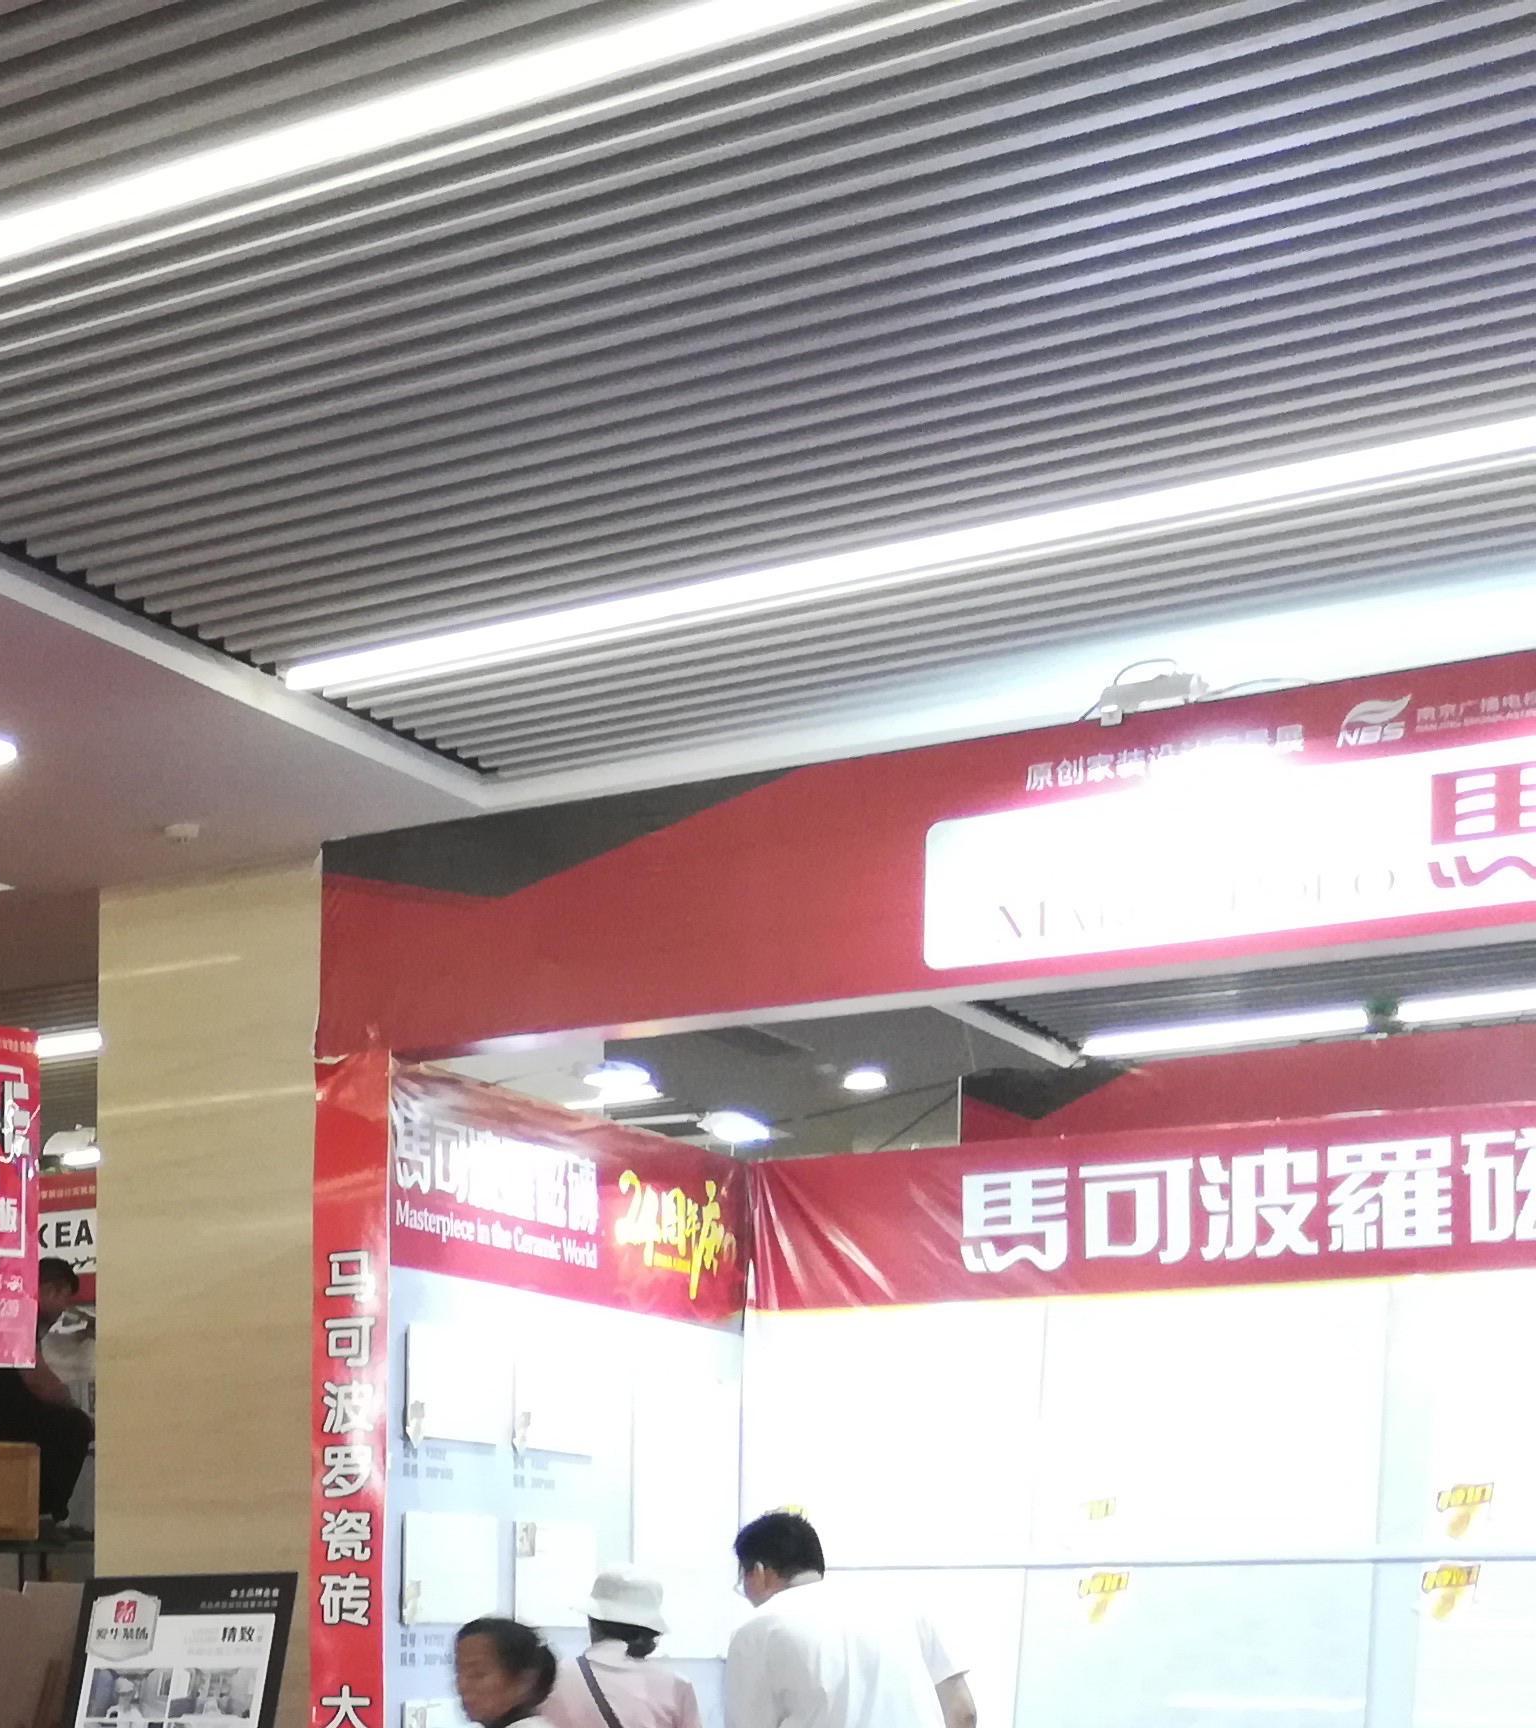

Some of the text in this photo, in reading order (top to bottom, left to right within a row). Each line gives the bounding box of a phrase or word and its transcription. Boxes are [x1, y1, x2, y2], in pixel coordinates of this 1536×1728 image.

[395, 1199, 598, 1269] Masterpiece in the Ceramic World
[320, 1250, 377, 1629] 马可波罗瓷砖
